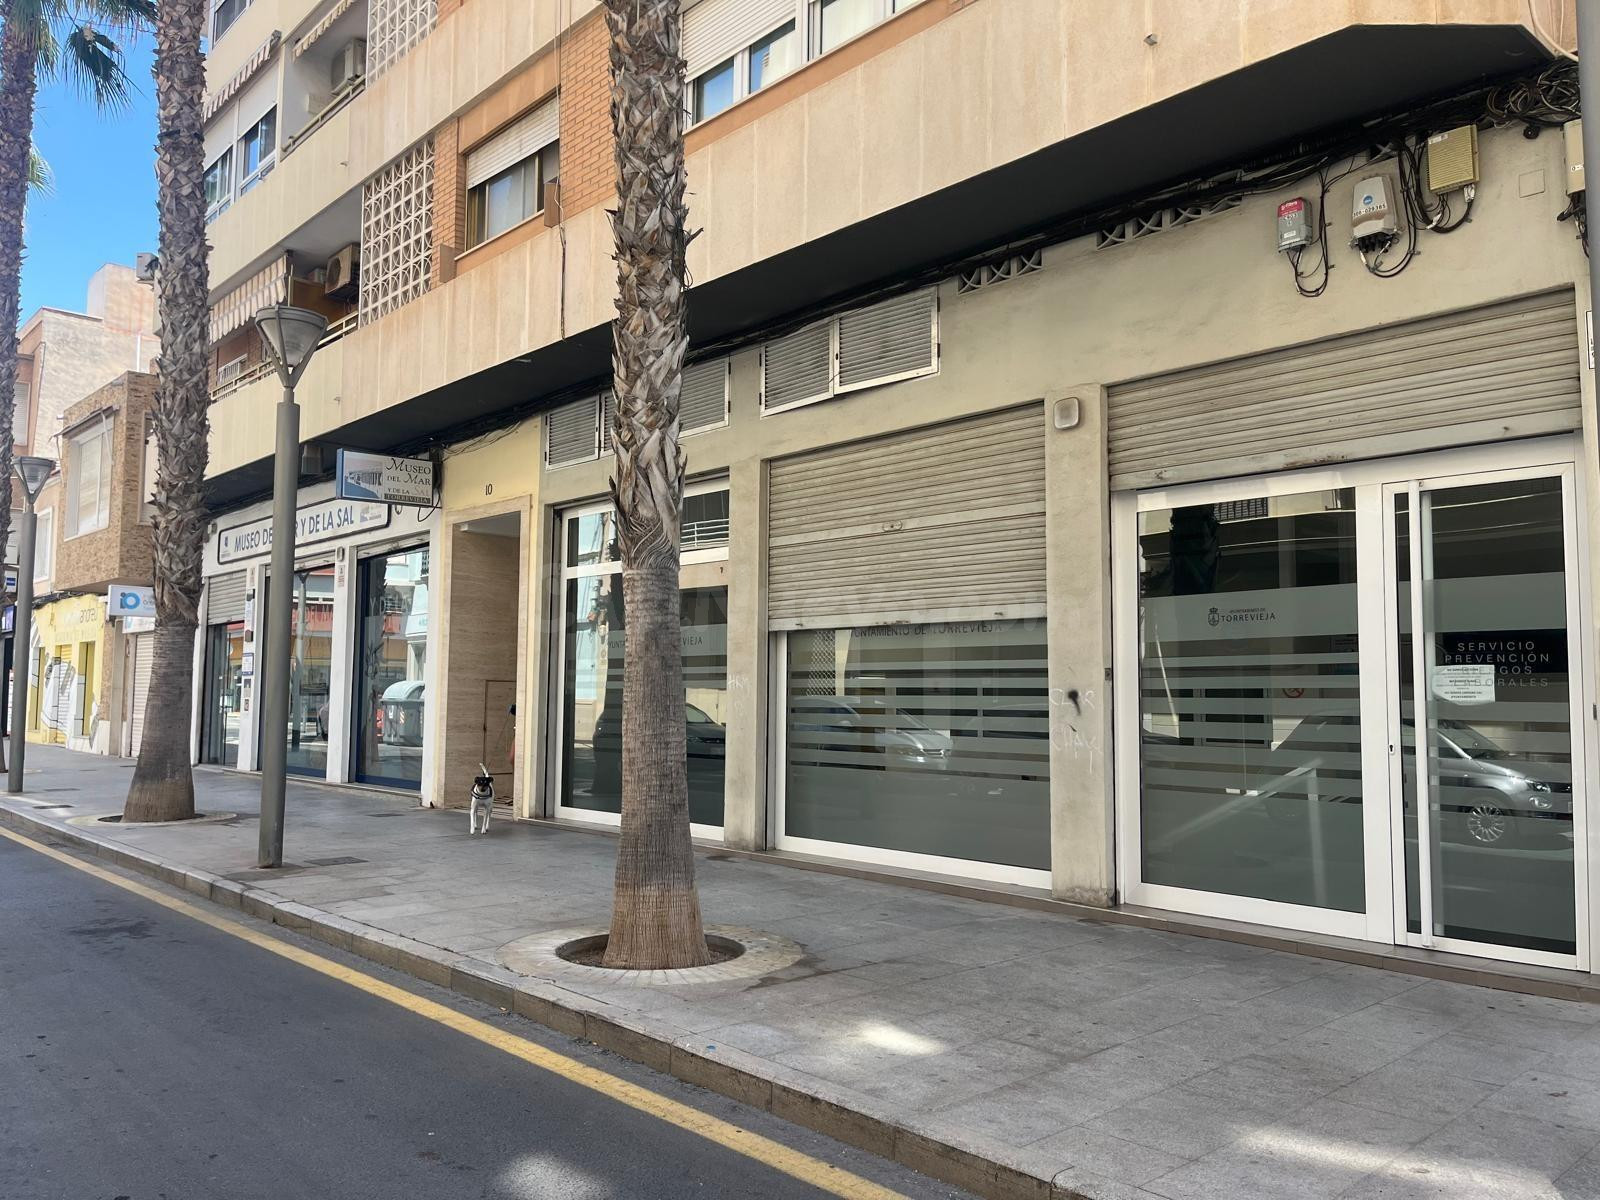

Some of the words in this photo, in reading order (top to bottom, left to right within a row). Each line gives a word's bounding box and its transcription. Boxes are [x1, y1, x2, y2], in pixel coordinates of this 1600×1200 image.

[386, 457, 431, 474] MUSEO
[387, 475, 401, 483] DEL
[403, 472, 431, 486] MAR
[485, 483, 493, 496] 10
[234, 529, 261, 553] MUSEO
[262, 527, 273, 546] DE
[301, 517, 307, 537] Y
[308, 513, 320, 535] DE
[322, 511, 334, 531] LA
[336, 505, 354, 528] SAL
[1221, 612, 1276, 623] TORREVIEJA
[1457, 641, 1535, 652] SERVICIO
